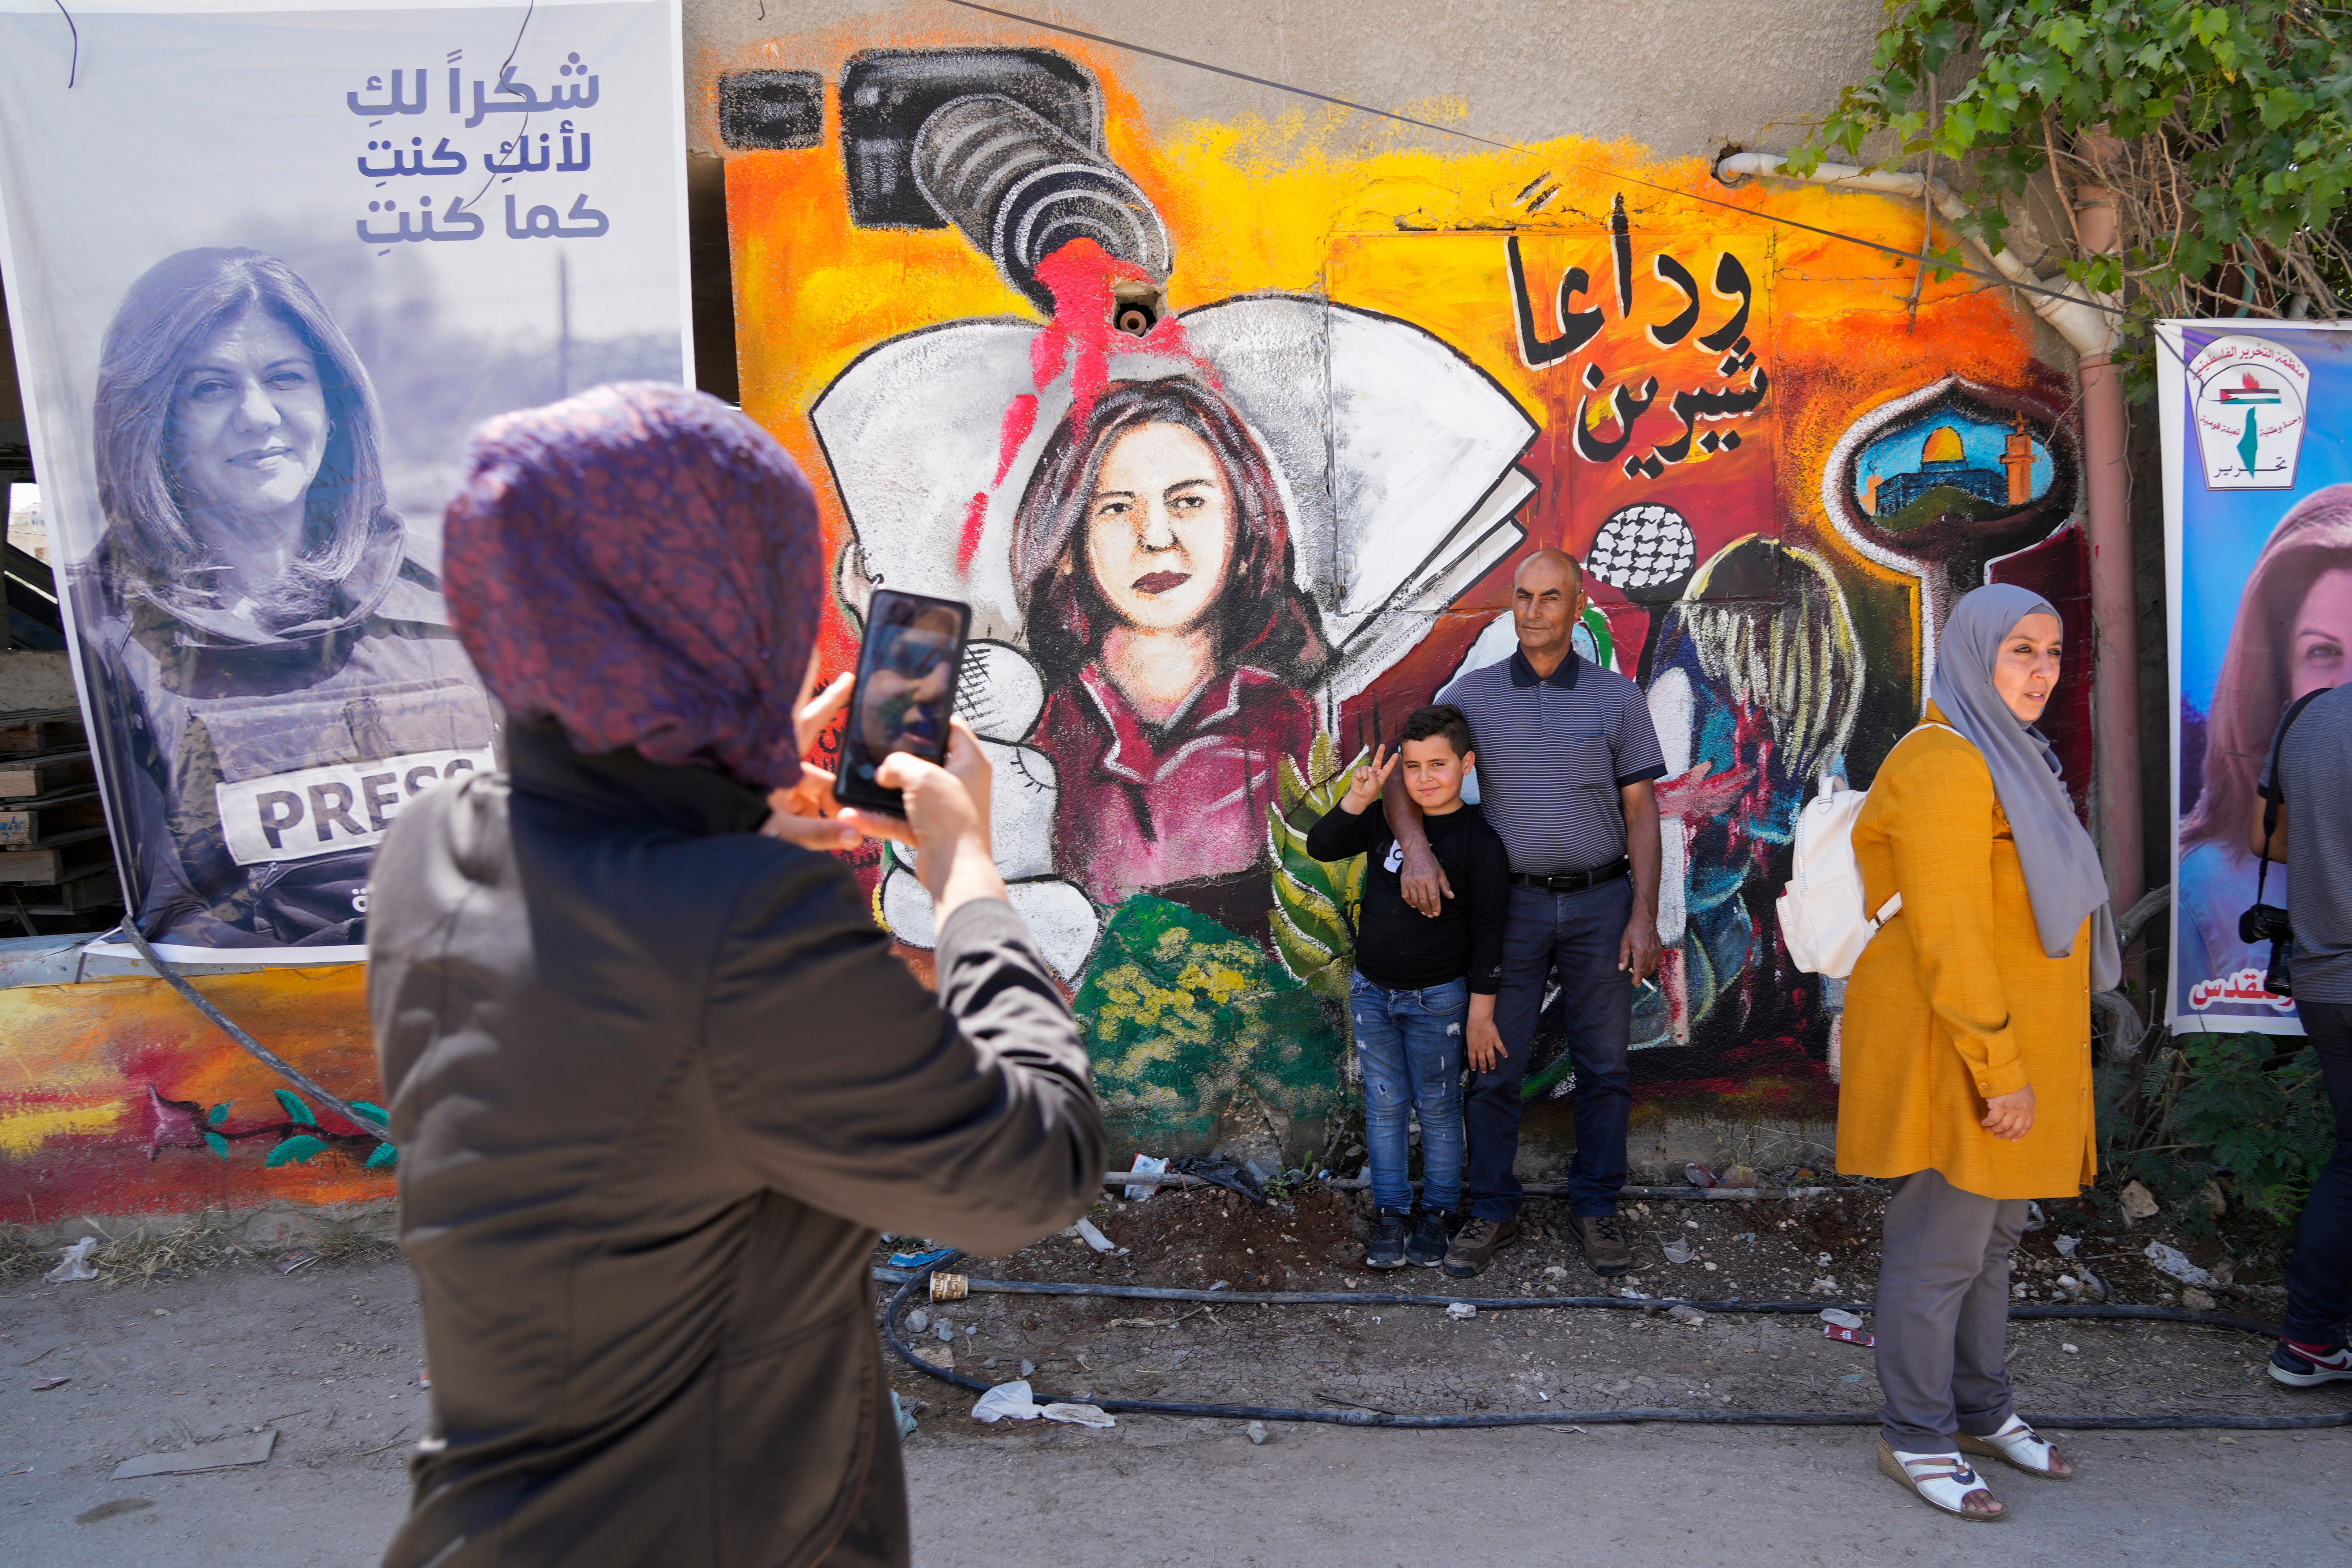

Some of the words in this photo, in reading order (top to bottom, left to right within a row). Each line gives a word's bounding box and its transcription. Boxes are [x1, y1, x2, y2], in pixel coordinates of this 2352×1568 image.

[447, 48, 599, 128] شكراً
[505, 193, 609, 239] كما
[1573, 336, 1768, 480] شيرين
[2213, 457, 2287, 477] تحرير
